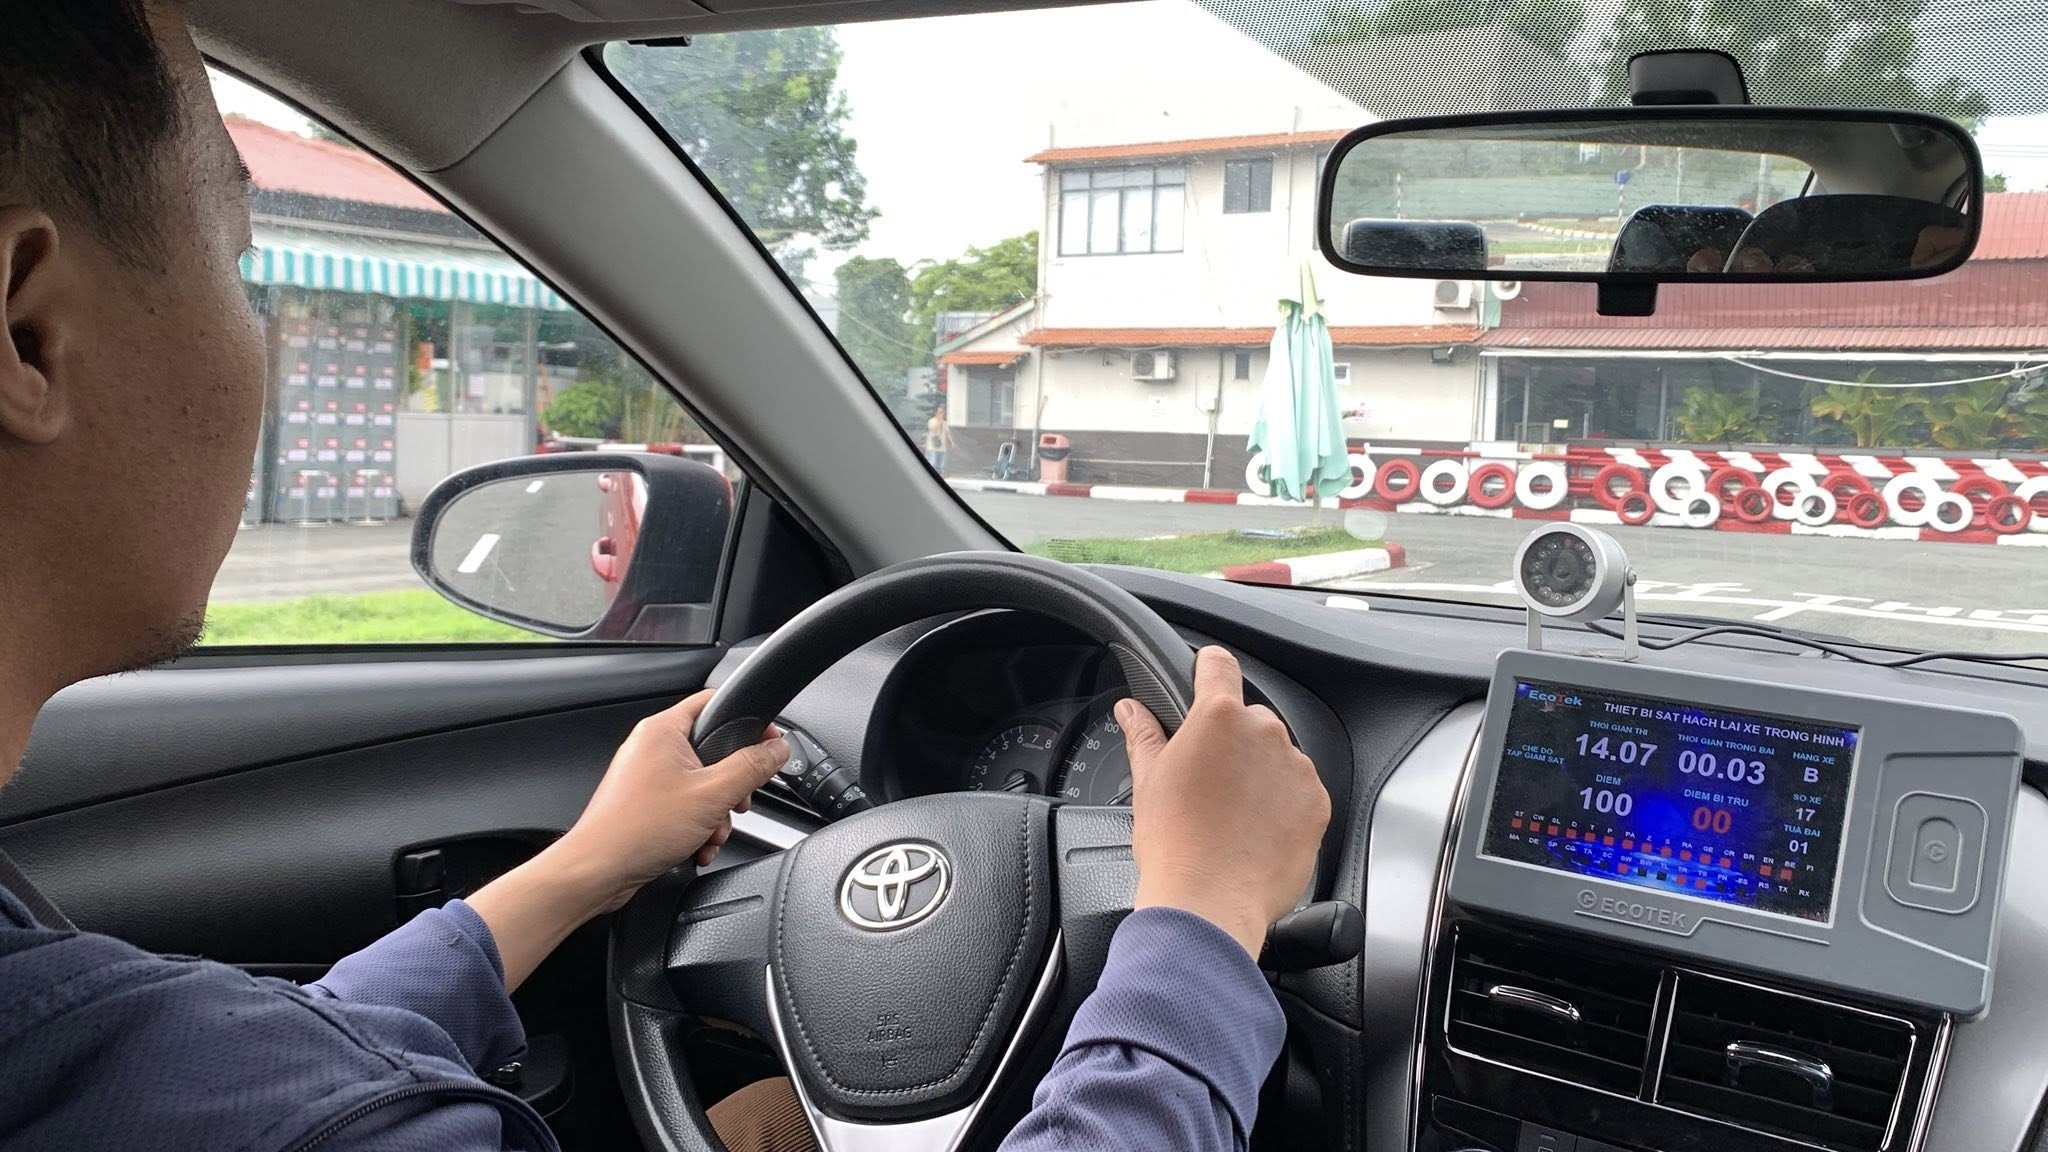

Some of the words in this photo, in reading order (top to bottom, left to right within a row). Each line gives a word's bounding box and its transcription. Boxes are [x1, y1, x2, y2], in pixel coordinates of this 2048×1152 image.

[1528, 690, 1582, 706] EcoTek
[1104, 722, 1120, 734] 100
[1589, 720, 1609, 730] THOI
[1611, 724, 1632, 734] GIAN
[1634, 727, 1648, 736] THI
[1604, 702, 1638, 716] THIET
[1640, 708, 1652, 718] BI
[1655, 710, 1680, 722] SAT
[1682, 714, 1717, 728] HACH
[1720, 720, 1740, 732] LAI
[1743, 723, 1760, 735] XE
[1764, 726, 1809, 741] TRONG
[1812, 734, 1845, 747] HINH
[1002, 741, 1010, 750] 5
[1016, 734, 1024, 744] 6
[1032, 734, 1040, 744] 7
[1045, 739, 1052, 749] 8
[1086, 739, 1100, 751] 80
[1678, 734, 1699, 744] THOI
[1700, 737, 1723, 747] GIAN
[1725, 741, 1757, 753] TRONG
[1759, 746, 1776, 756] BAI
[988, 751, 996, 760] 4
[1507, 748, 1523, 757] TAP
[1524, 751, 1546, 762] GIAM
[1548, 756, 1565, 765] SAT
[1522, 744, 1538, 753] CHE
[1540, 747, 1554, 755] DO
[1576, 734, 1658, 766] 14.07
[1792, 751, 1820, 762] HANG
[1822, 756, 1835, 765] XE
[980, 765, 988, 775] 3
[1072, 762, 1086, 772] 60
[1678, 750, 1766, 785] 00.03
[1596, 774, 1622, 786] DIEM
[1803, 766, 1819, 783] B
[1066, 786, 1080, 798] 40
[1684, 789, 1710, 802] DIEM
[1713, 794, 1724, 802] BI
[1728, 796, 1749, 807] TRU
[1793, 794, 1806, 802] SO
[1810, 796, 1822, 804] XE
[1580, 786, 1633, 817] 100
[1692, 806, 1732, 834] 00
[1795, 808, 1816, 822] 17
[1784, 824, 1802, 834] TUA
[1804, 828, 1820, 837] BAI
[1789, 840, 1809, 854] 01
[1763, 856, 1774, 864] EN
[1784, 860, 1796, 868] BE
[1806, 864, 1814, 872] FI
[1799, 889, 1810, 897] RX
[1601, 897, 1687, 928] ECOTEK
